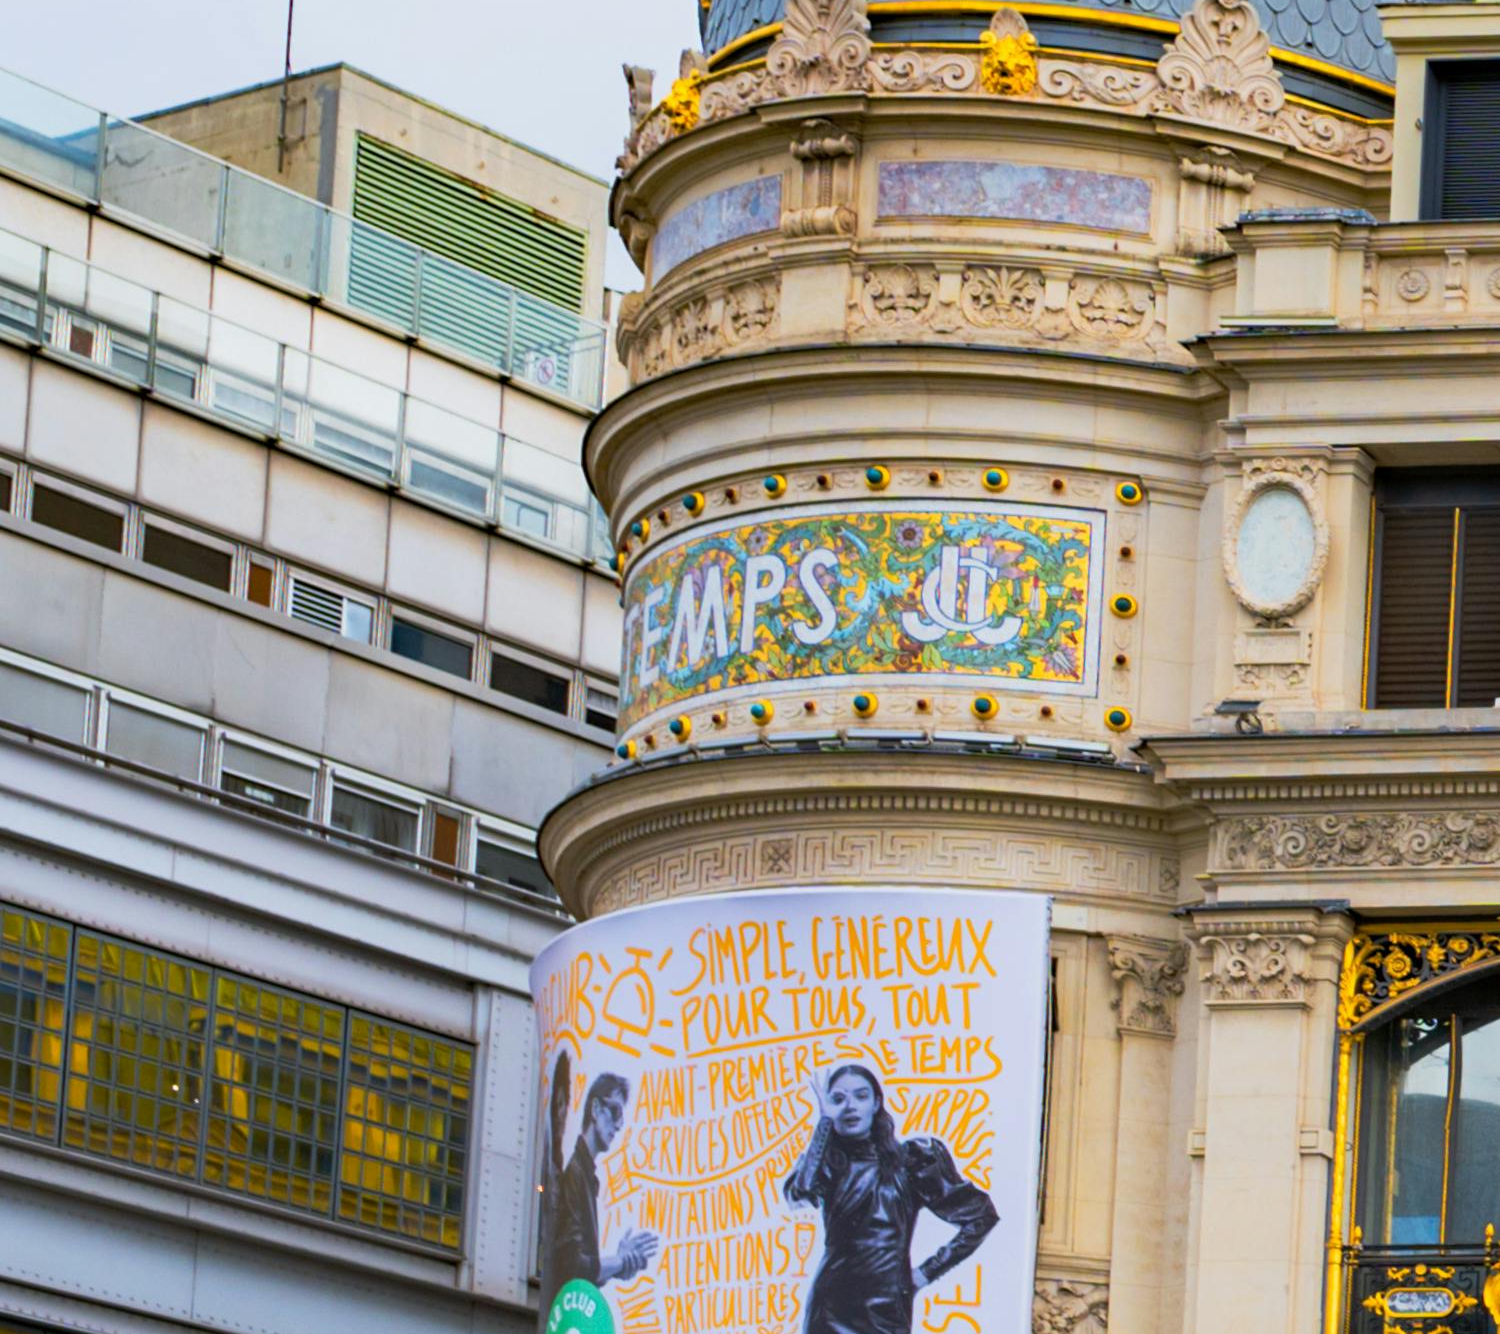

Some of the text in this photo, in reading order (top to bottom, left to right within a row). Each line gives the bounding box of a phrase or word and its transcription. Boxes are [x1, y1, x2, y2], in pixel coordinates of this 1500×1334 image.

[681, 990, 780, 1051] POUR
[884, 984, 982, 1030] TOUT
[893, 1033, 1003, 1085] TEMPS
[632, 1085, 814, 1177] SERVICES OFFERTS
[639, 1171, 754, 1240] INVITATIONS
[657, 1226, 791, 1290] ATTENTIONS
[563, 1291, 597, 1318] CLUB
